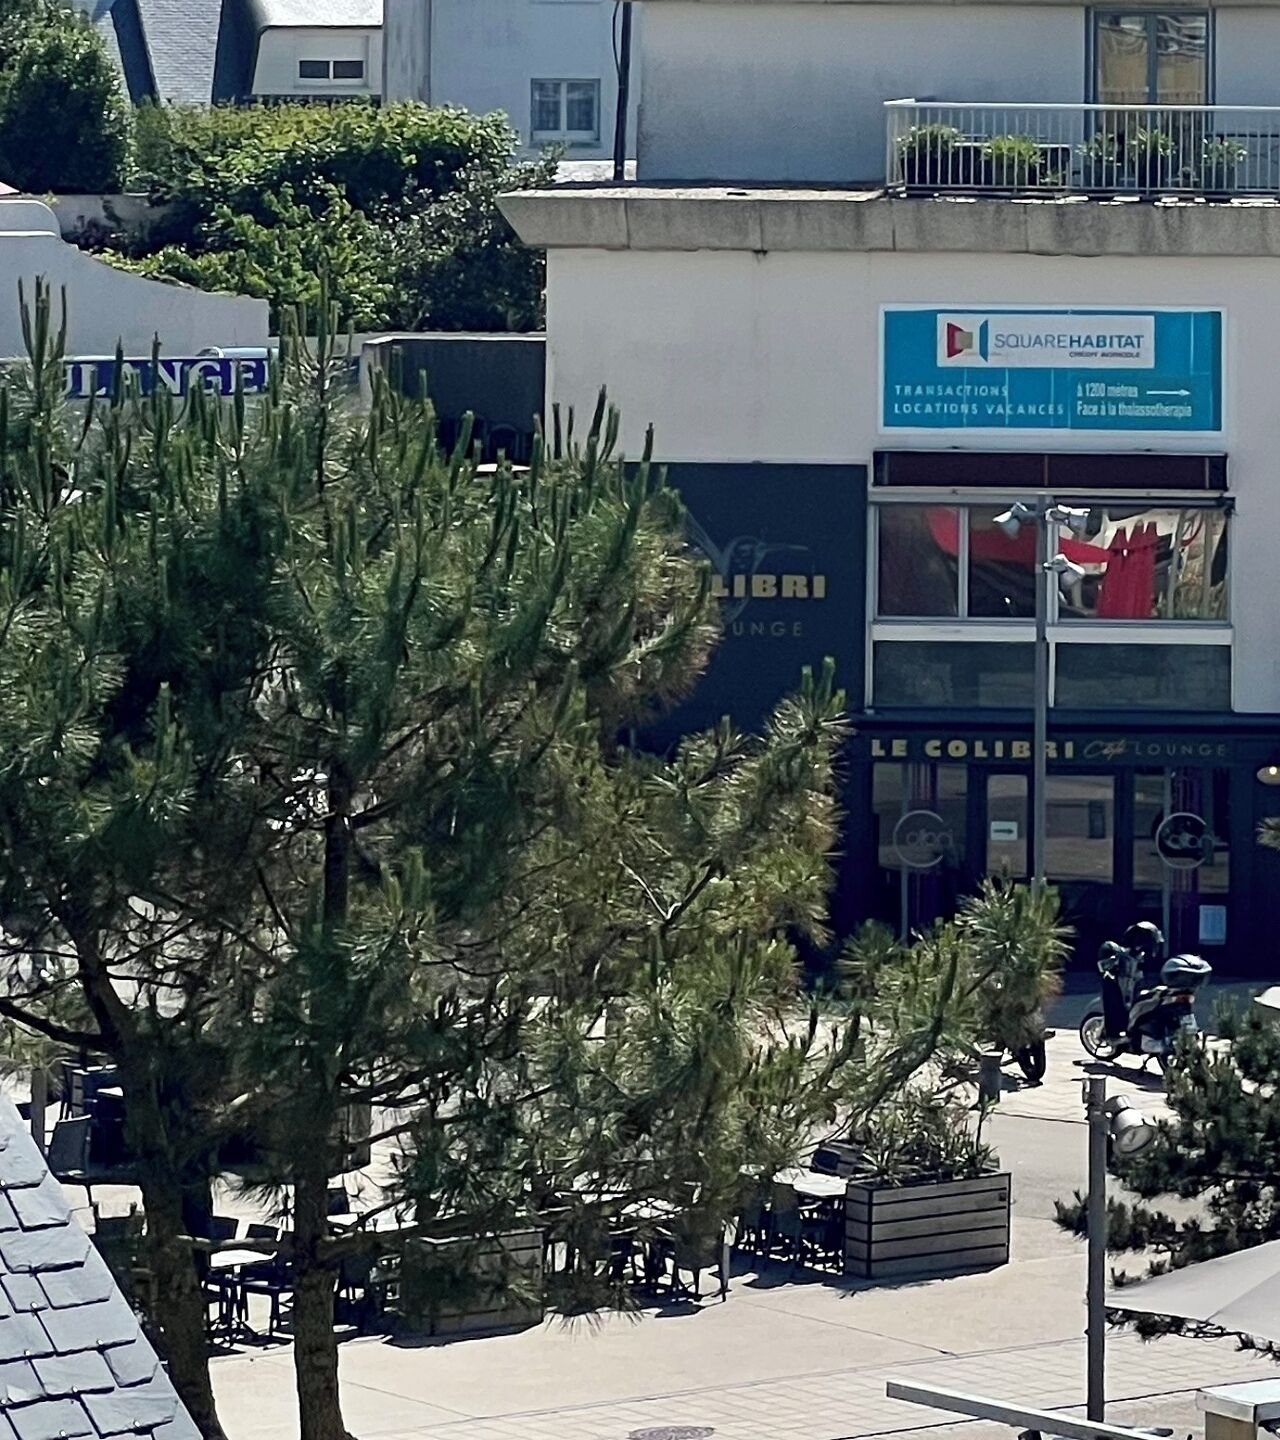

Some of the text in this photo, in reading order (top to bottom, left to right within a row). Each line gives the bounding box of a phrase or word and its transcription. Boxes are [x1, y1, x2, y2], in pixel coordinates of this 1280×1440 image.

[994, 334, 1144, 348] SQUAREHABITAT
[894, 385, 1008, 396] TRANSACTIONS
[894, 403, 1064, 415] LOCATIONS VACANCES
[1077, 401, 1098, 416] Face
[711, 574, 826, 598] LIBRI
[871, 739, 907, 757] LE
[924, 739, 1074, 759] COLIBRI
[1136, 743, 1226, 756] LOUNGE
